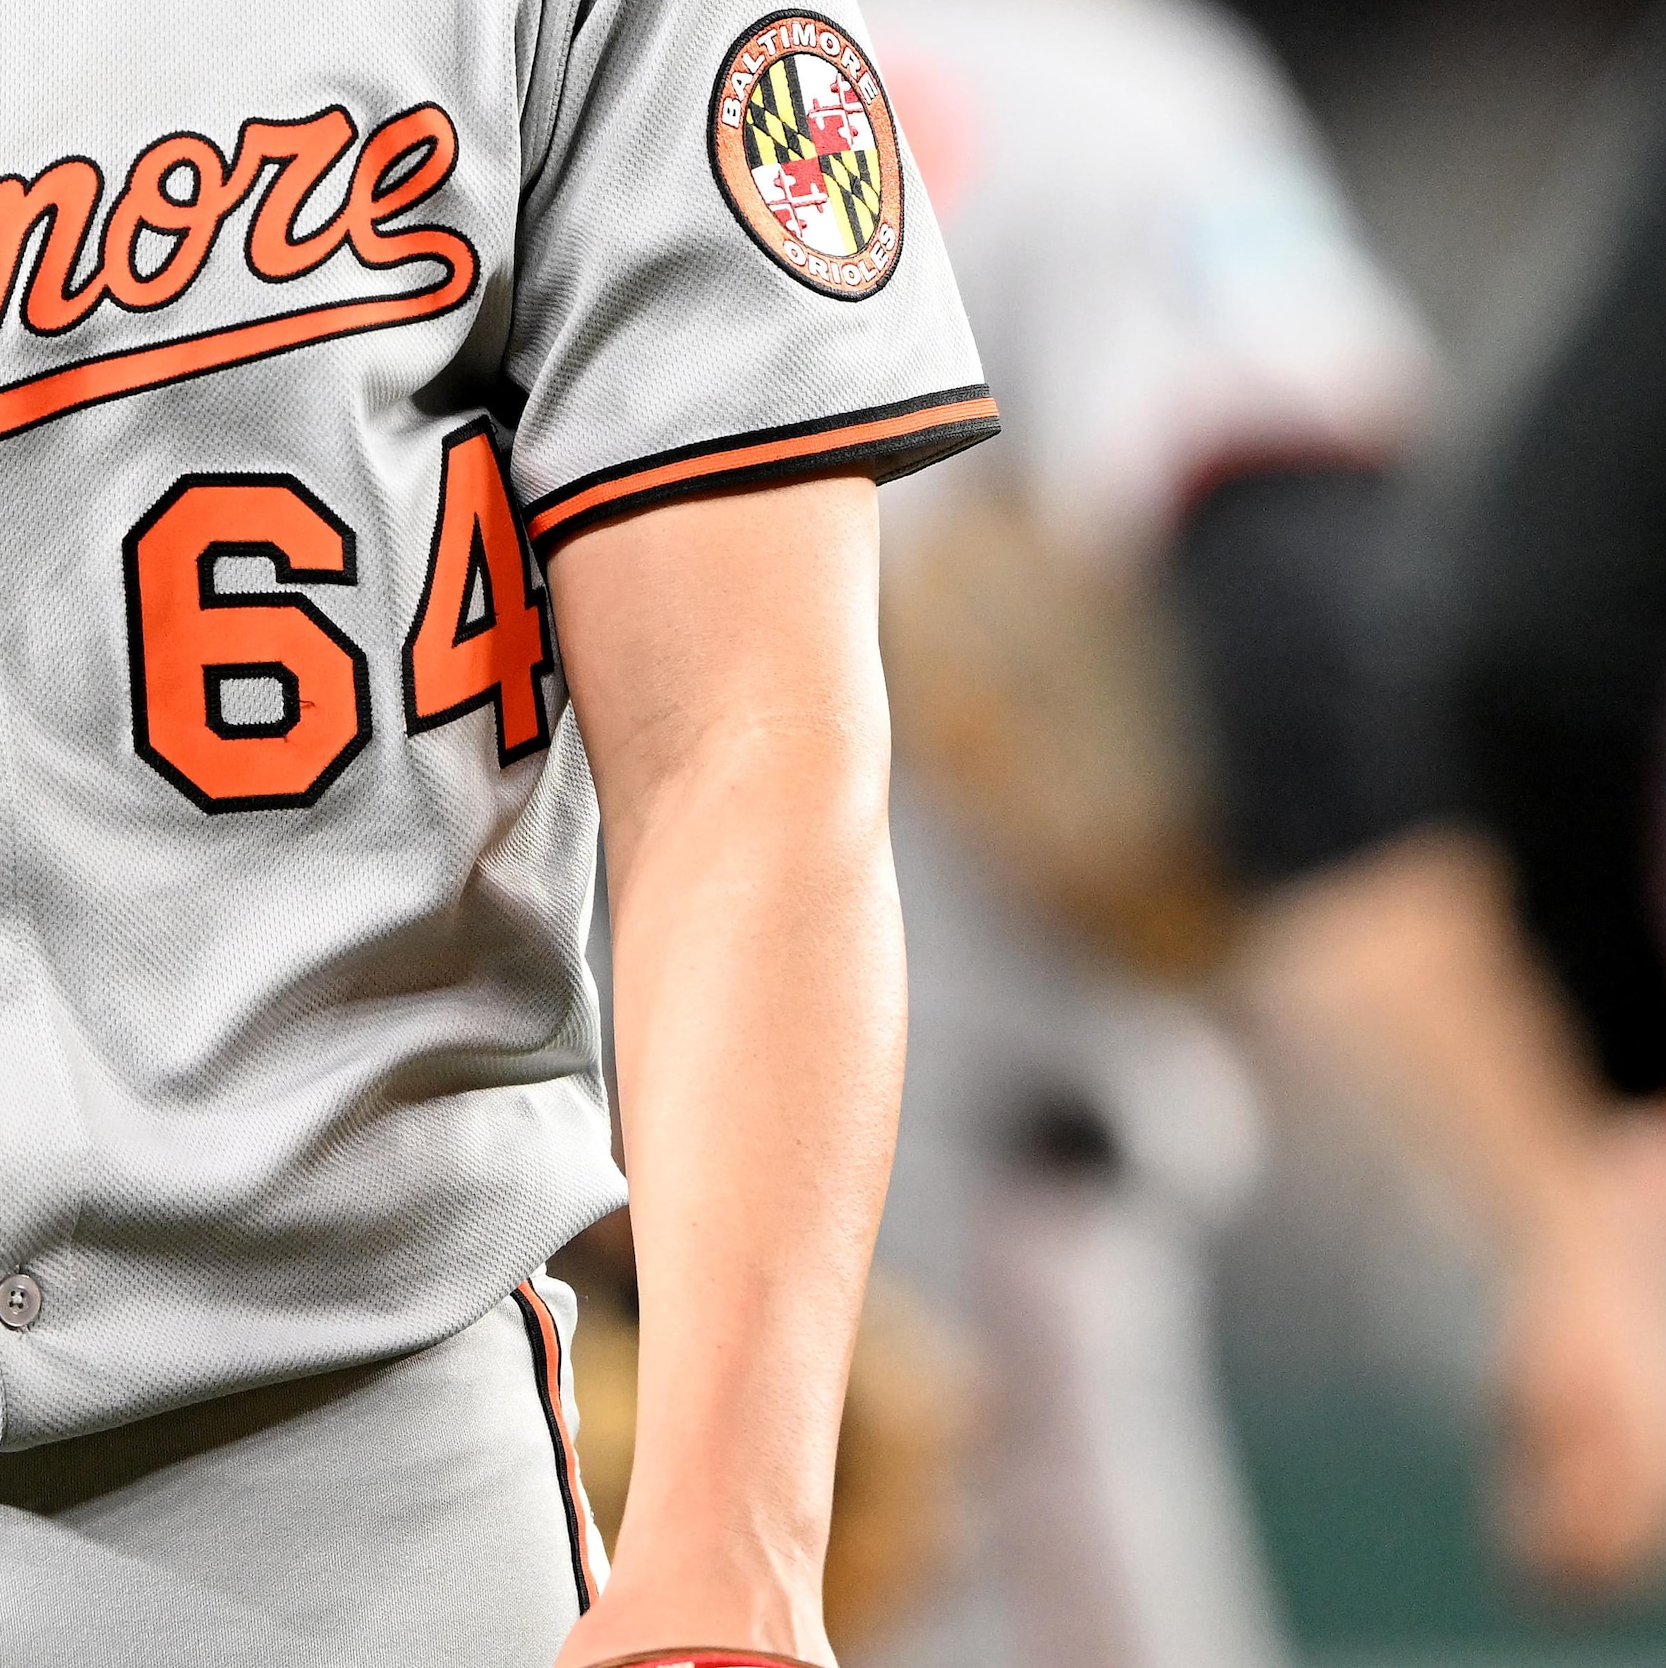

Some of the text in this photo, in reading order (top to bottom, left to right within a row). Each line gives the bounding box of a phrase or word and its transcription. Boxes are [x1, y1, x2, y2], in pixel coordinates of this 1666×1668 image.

[720, 21, 879, 129] BALTIMORE
[781, 221, 897, 287] ORIOLES
[123, 414, 556, 815] 64
